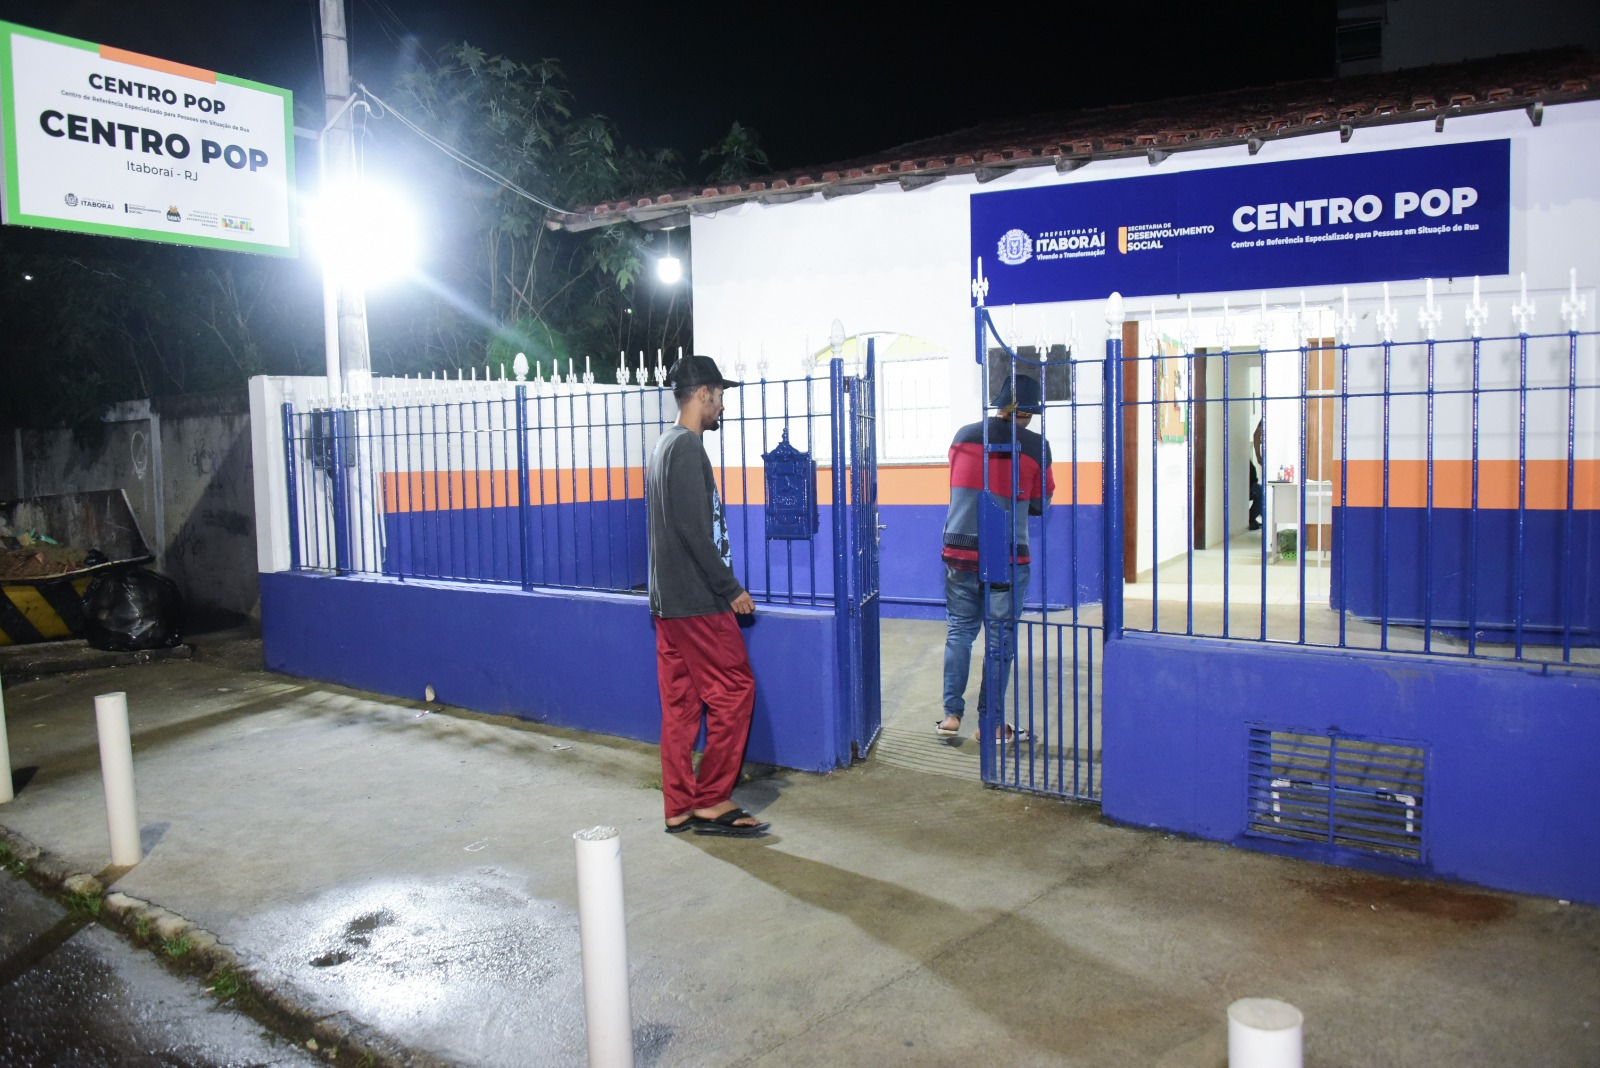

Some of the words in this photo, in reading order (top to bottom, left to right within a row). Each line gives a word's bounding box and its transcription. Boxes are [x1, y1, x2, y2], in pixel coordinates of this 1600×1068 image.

[88, 73, 178, 105] CENTRO
[184, 93, 226, 115] POP
[61, 90, 82, 99] Centro
[92, 96, 124, 107] Referência
[124, 103, 163, 115] Especializado
[163, 111, 176, 119] para
[177, 114, 199, 123] Pessoas
[209, 119, 231, 130] Situação
[39, 109, 191, 160] CENTRO
[201, 138, 269, 173] POP
[127, 160, 174, 178] Itaboraí
[184, 170, 198, 182] RJ
[1232, 194, 1383, 233] CENTRO
[1394, 186, 1479, 220] POP
[1039, 228, 1087, 238] PREFEITURA
[1127, 223, 1163, 232] SECRETARIA
[1127, 225, 1215, 241] DESENVOLVIMENTO
[1231, 241, 1255, 249] Centro
[1256, 239, 1265, 247] de
[1266, 235, 1304, 246] Referência
[1305, 232, 1354, 244] Especializado
[1354, 231, 1372, 241] para
[1372, 229, 1403, 238] Pessoas
[1404, 228, 1417, 236] em
[1417, 224, 1451, 235] Situação
[1452, 223, 1463, 232] de
[1463, 223, 1480, 231] Rua
[1036, 231, 1106, 253] ITABORAÍ
[1127, 240, 1164, 252] SOCIAL
[1036, 252, 1059, 261] Vivendo
[1063, 248, 1106, 259] Transformação!
